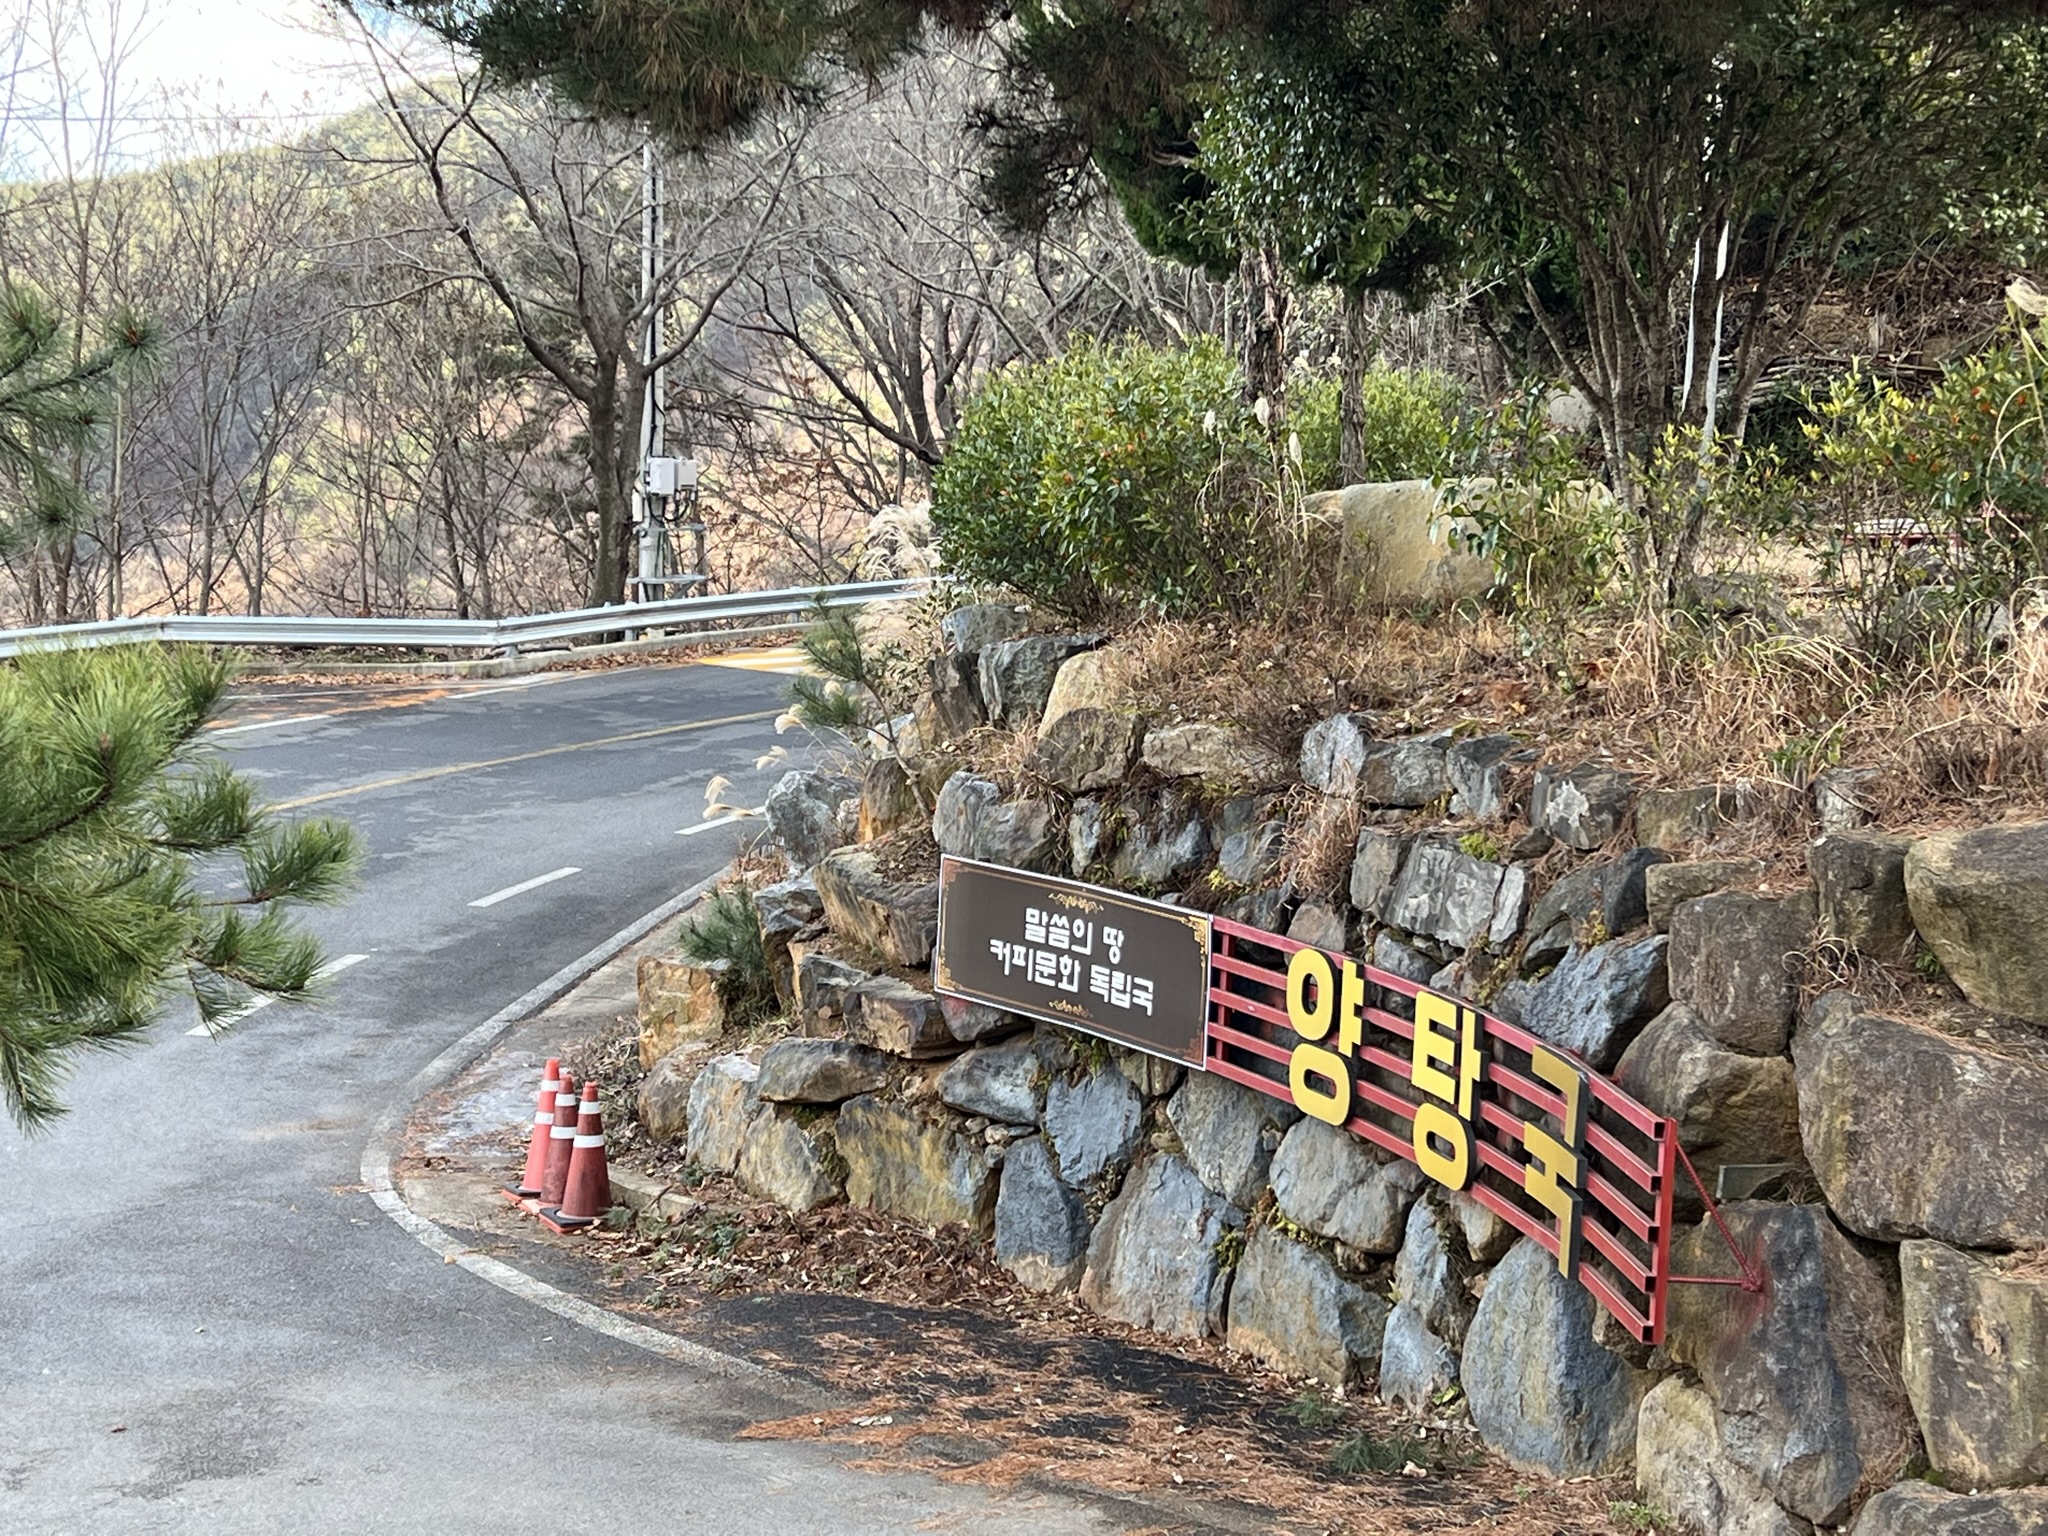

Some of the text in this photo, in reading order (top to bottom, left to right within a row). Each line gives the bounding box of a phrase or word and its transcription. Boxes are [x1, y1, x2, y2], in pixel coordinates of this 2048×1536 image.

[1025, 907, 1125, 965] 말씀의 땅
[989, 938, 1154, 1017] 커피문화 독립국
[1286, 948, 1584, 1280] 양탕국
